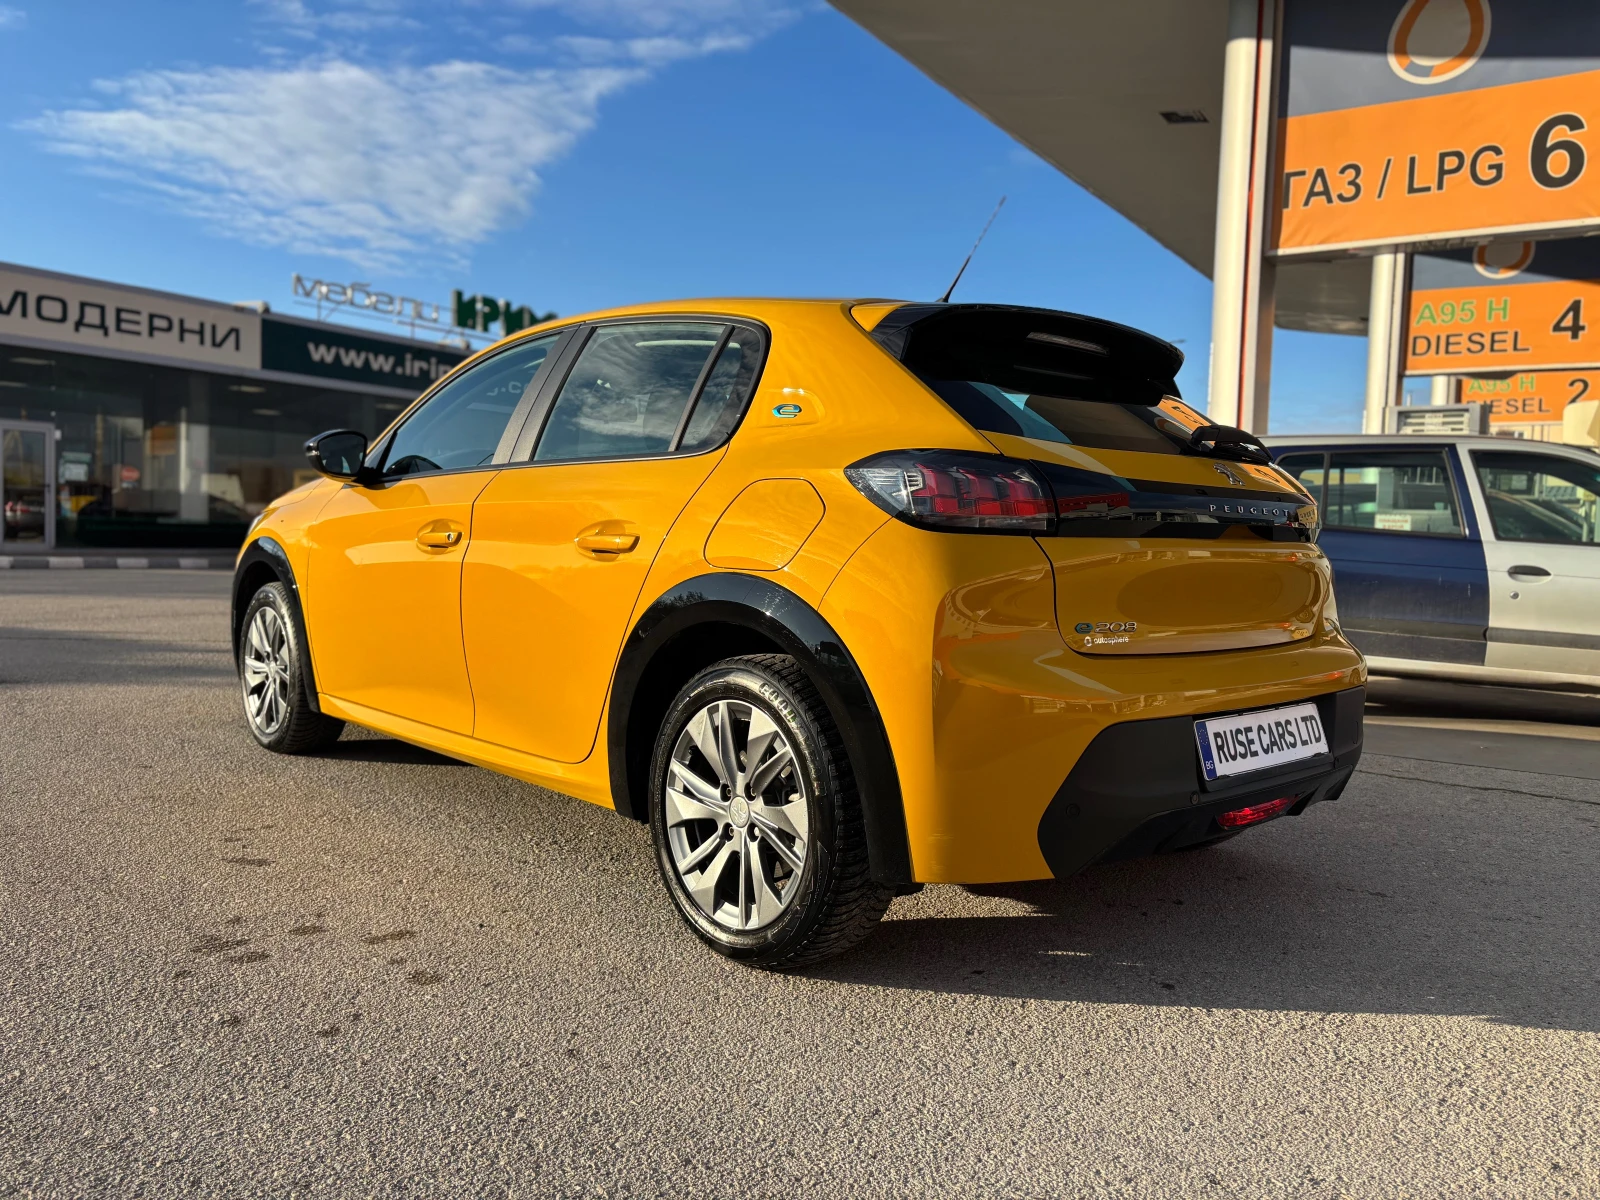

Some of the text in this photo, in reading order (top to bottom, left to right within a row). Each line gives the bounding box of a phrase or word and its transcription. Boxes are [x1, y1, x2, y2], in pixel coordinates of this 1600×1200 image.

[1282, 113, 1587, 210] ГАЗ / LPG 6
[0, 290, 241, 351] МОДЕРНИ
[1415, 300, 1476, 326] A95
[1551, 299, 1586, 341] 4
[1411, 331, 1531, 356] DIESEL
[1566, 378, 1590, 405] 2
[1209, 504, 1289, 517] PEUGEOT
[1093, 635, 1129, 646] autosphere
[1213, 714, 1322, 764] RUSE CARS LTD
